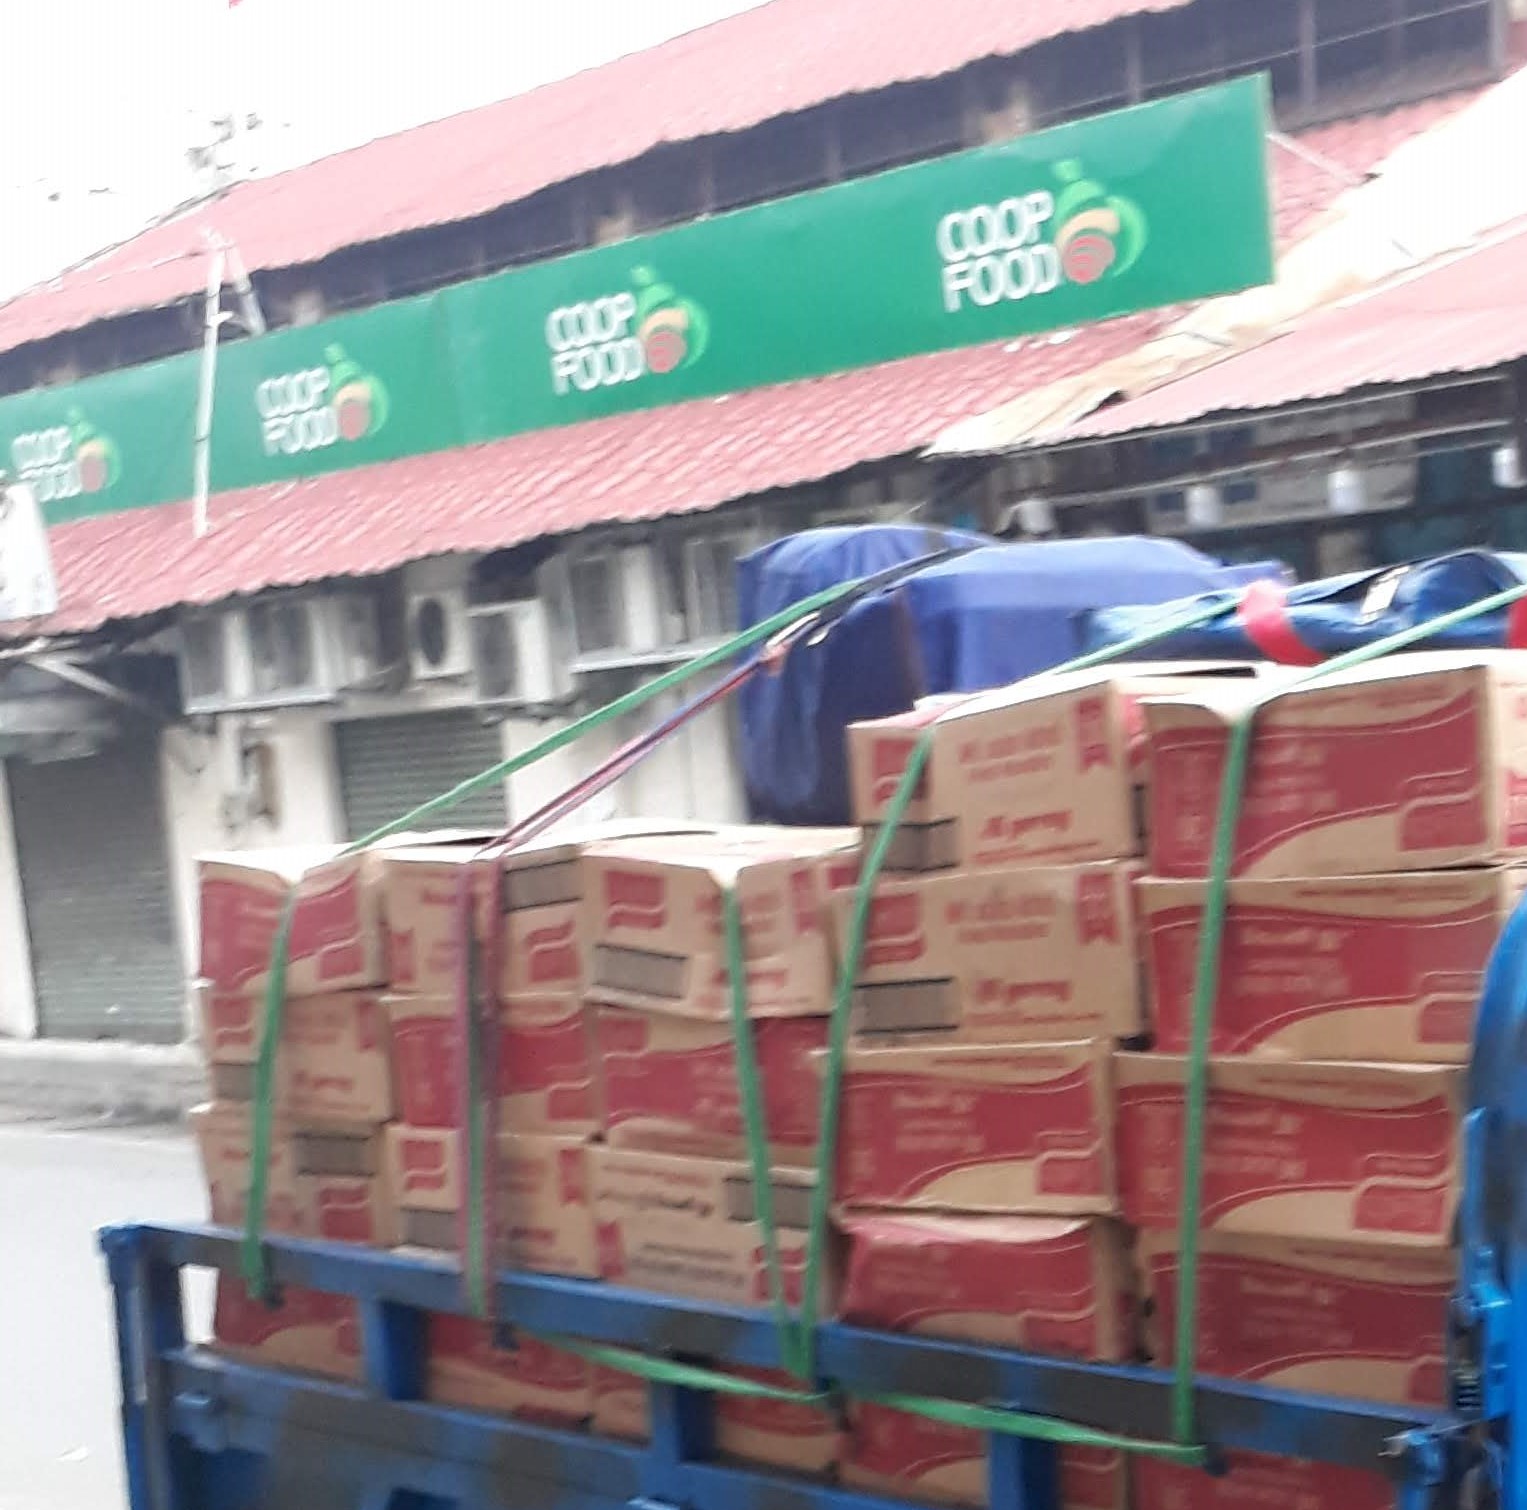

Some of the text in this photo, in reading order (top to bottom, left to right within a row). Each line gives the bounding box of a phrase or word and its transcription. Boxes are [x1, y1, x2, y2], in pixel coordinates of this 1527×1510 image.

[943, 242, 1064, 313] FOOD
[550, 337, 647, 396] FOOD
[262, 404, 340, 458] FOOD
